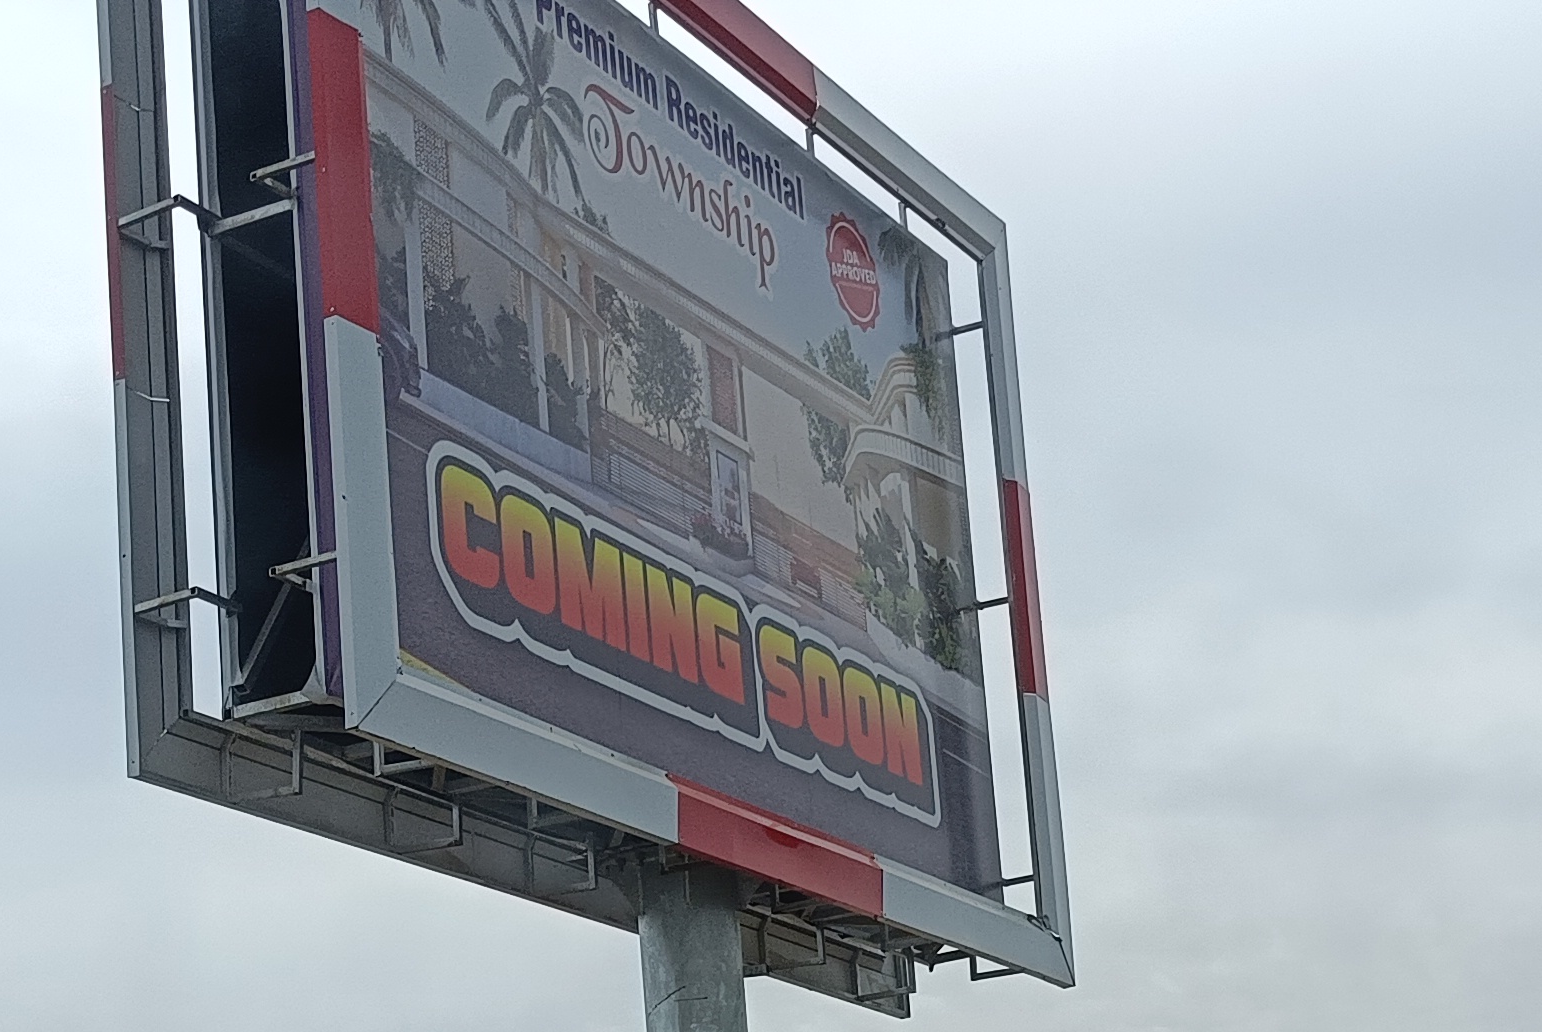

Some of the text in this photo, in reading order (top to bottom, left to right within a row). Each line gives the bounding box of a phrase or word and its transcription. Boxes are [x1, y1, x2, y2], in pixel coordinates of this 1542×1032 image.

[584, 83, 776, 292] Township
[664, 74, 804, 221] Residential
[831, 261, 877, 285] APPROVED
[842, 248, 861, 265] JDA
[440, 463, 924, 787] COMING SOON
